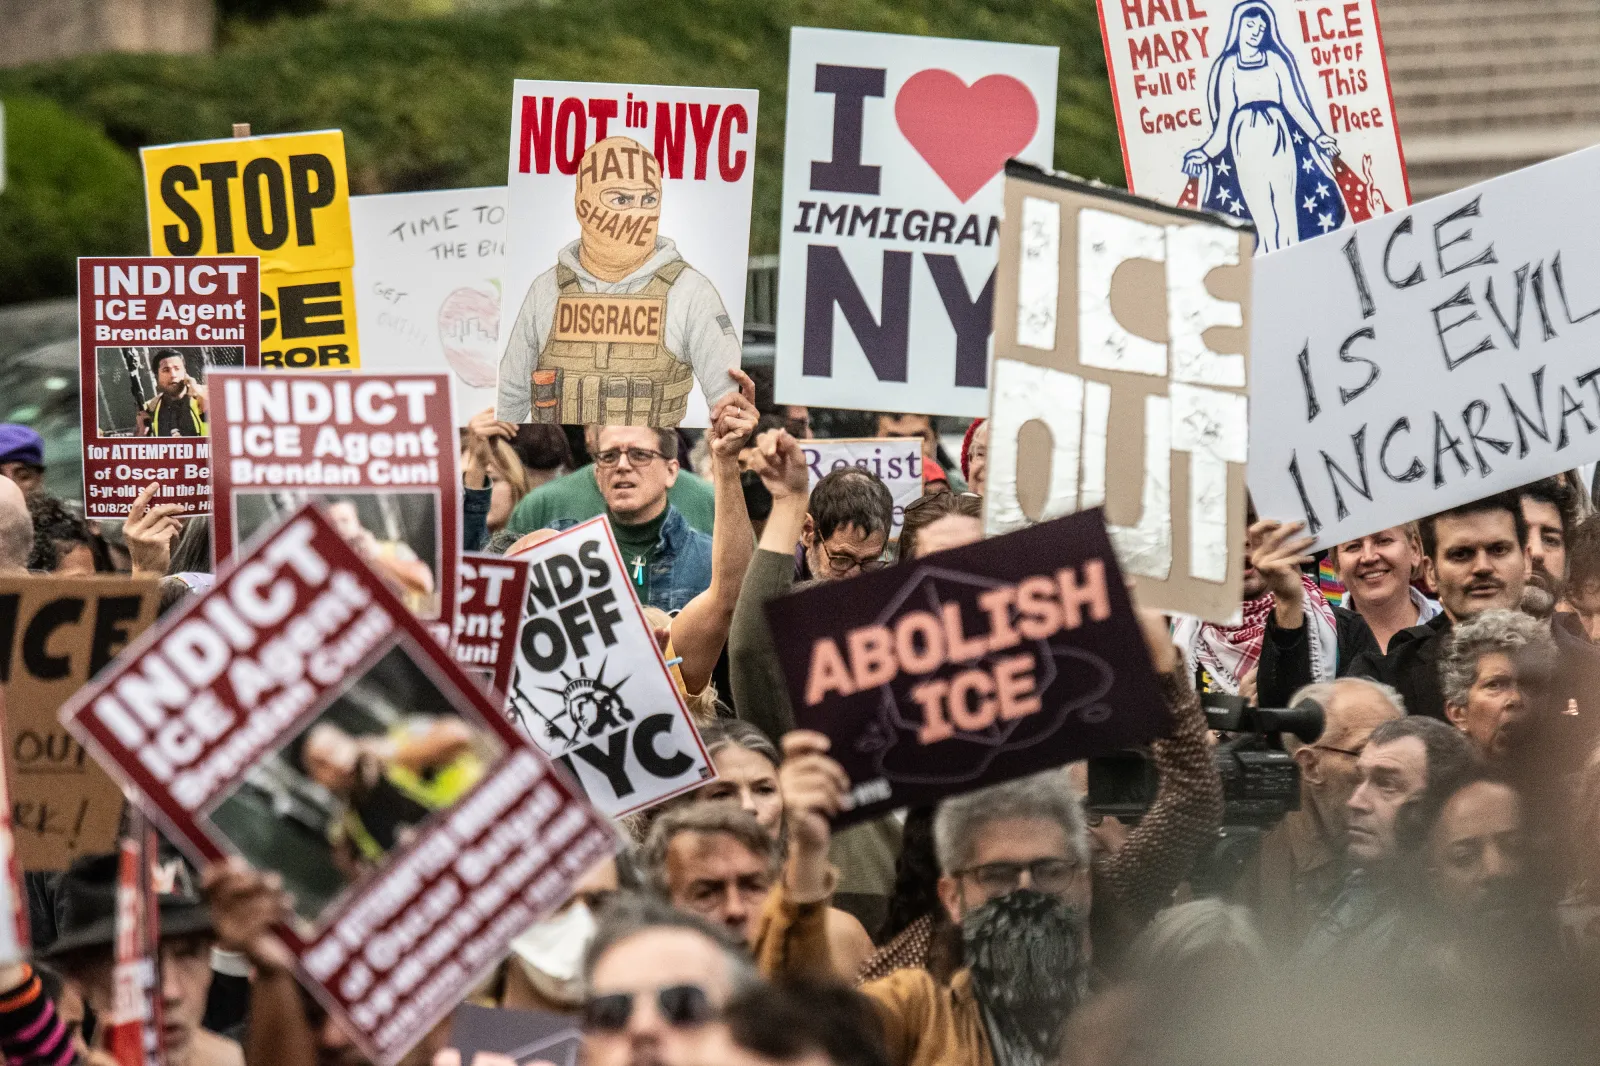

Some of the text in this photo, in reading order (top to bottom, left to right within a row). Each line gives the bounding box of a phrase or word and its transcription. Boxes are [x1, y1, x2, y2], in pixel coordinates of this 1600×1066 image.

[1121, 0, 1208, 30] HAIL
[1298, 1, 1364, 44] I.C.E
[1128, 26, 1210, 70] MARY
[1133, 72, 1173, 100] Full
[1318, 67, 1368, 99] This
[518, 92, 749, 183] NOT in NYC
[809, 62, 887, 196] I
[1139, 105, 1202, 135] Grace
[1328, 102, 1385, 134] Place
[579, 144, 657, 193] HATE
[160, 152, 337, 257] STOP
[388, 205, 506, 242] TIME TO
[576, 199, 659, 247] SHAME
[427, 241, 468, 261] THE
[1341, 192, 1500, 320] ICE
[93, 264, 247, 297] INDICT
[1016, 196, 1248, 388] ICE
[94, 299, 246, 325] ICE Agent
[95, 323, 245, 342] Brendan Cuni
[559, 302, 660, 336] DISGRACE
[802, 243, 1000, 390] NY
[1297, 249, 1600, 424] IS EVIL
[223, 378, 437, 426] INDICT
[87, 444, 110, 460] for
[111, 443, 194, 460] ATTEMPTED
[227, 424, 440, 465] ICE Agent
[89, 484, 137, 498] 5-yr-old
[162, 484, 175, 498] in
[176, 484, 195, 497] the
[94, 467, 112, 480] of
[115, 464, 179, 480] Oscar
[230, 458, 440, 485] Brendan Cuni
[983, 358, 1249, 584] OUT
[92, 514, 331, 752] INDICT
[520, 587, 624, 674] OFF
[804, 558, 1113, 708] ABOLISH
[912, 652, 1043, 747] ICE
[138, 690, 238, 782] ICE
